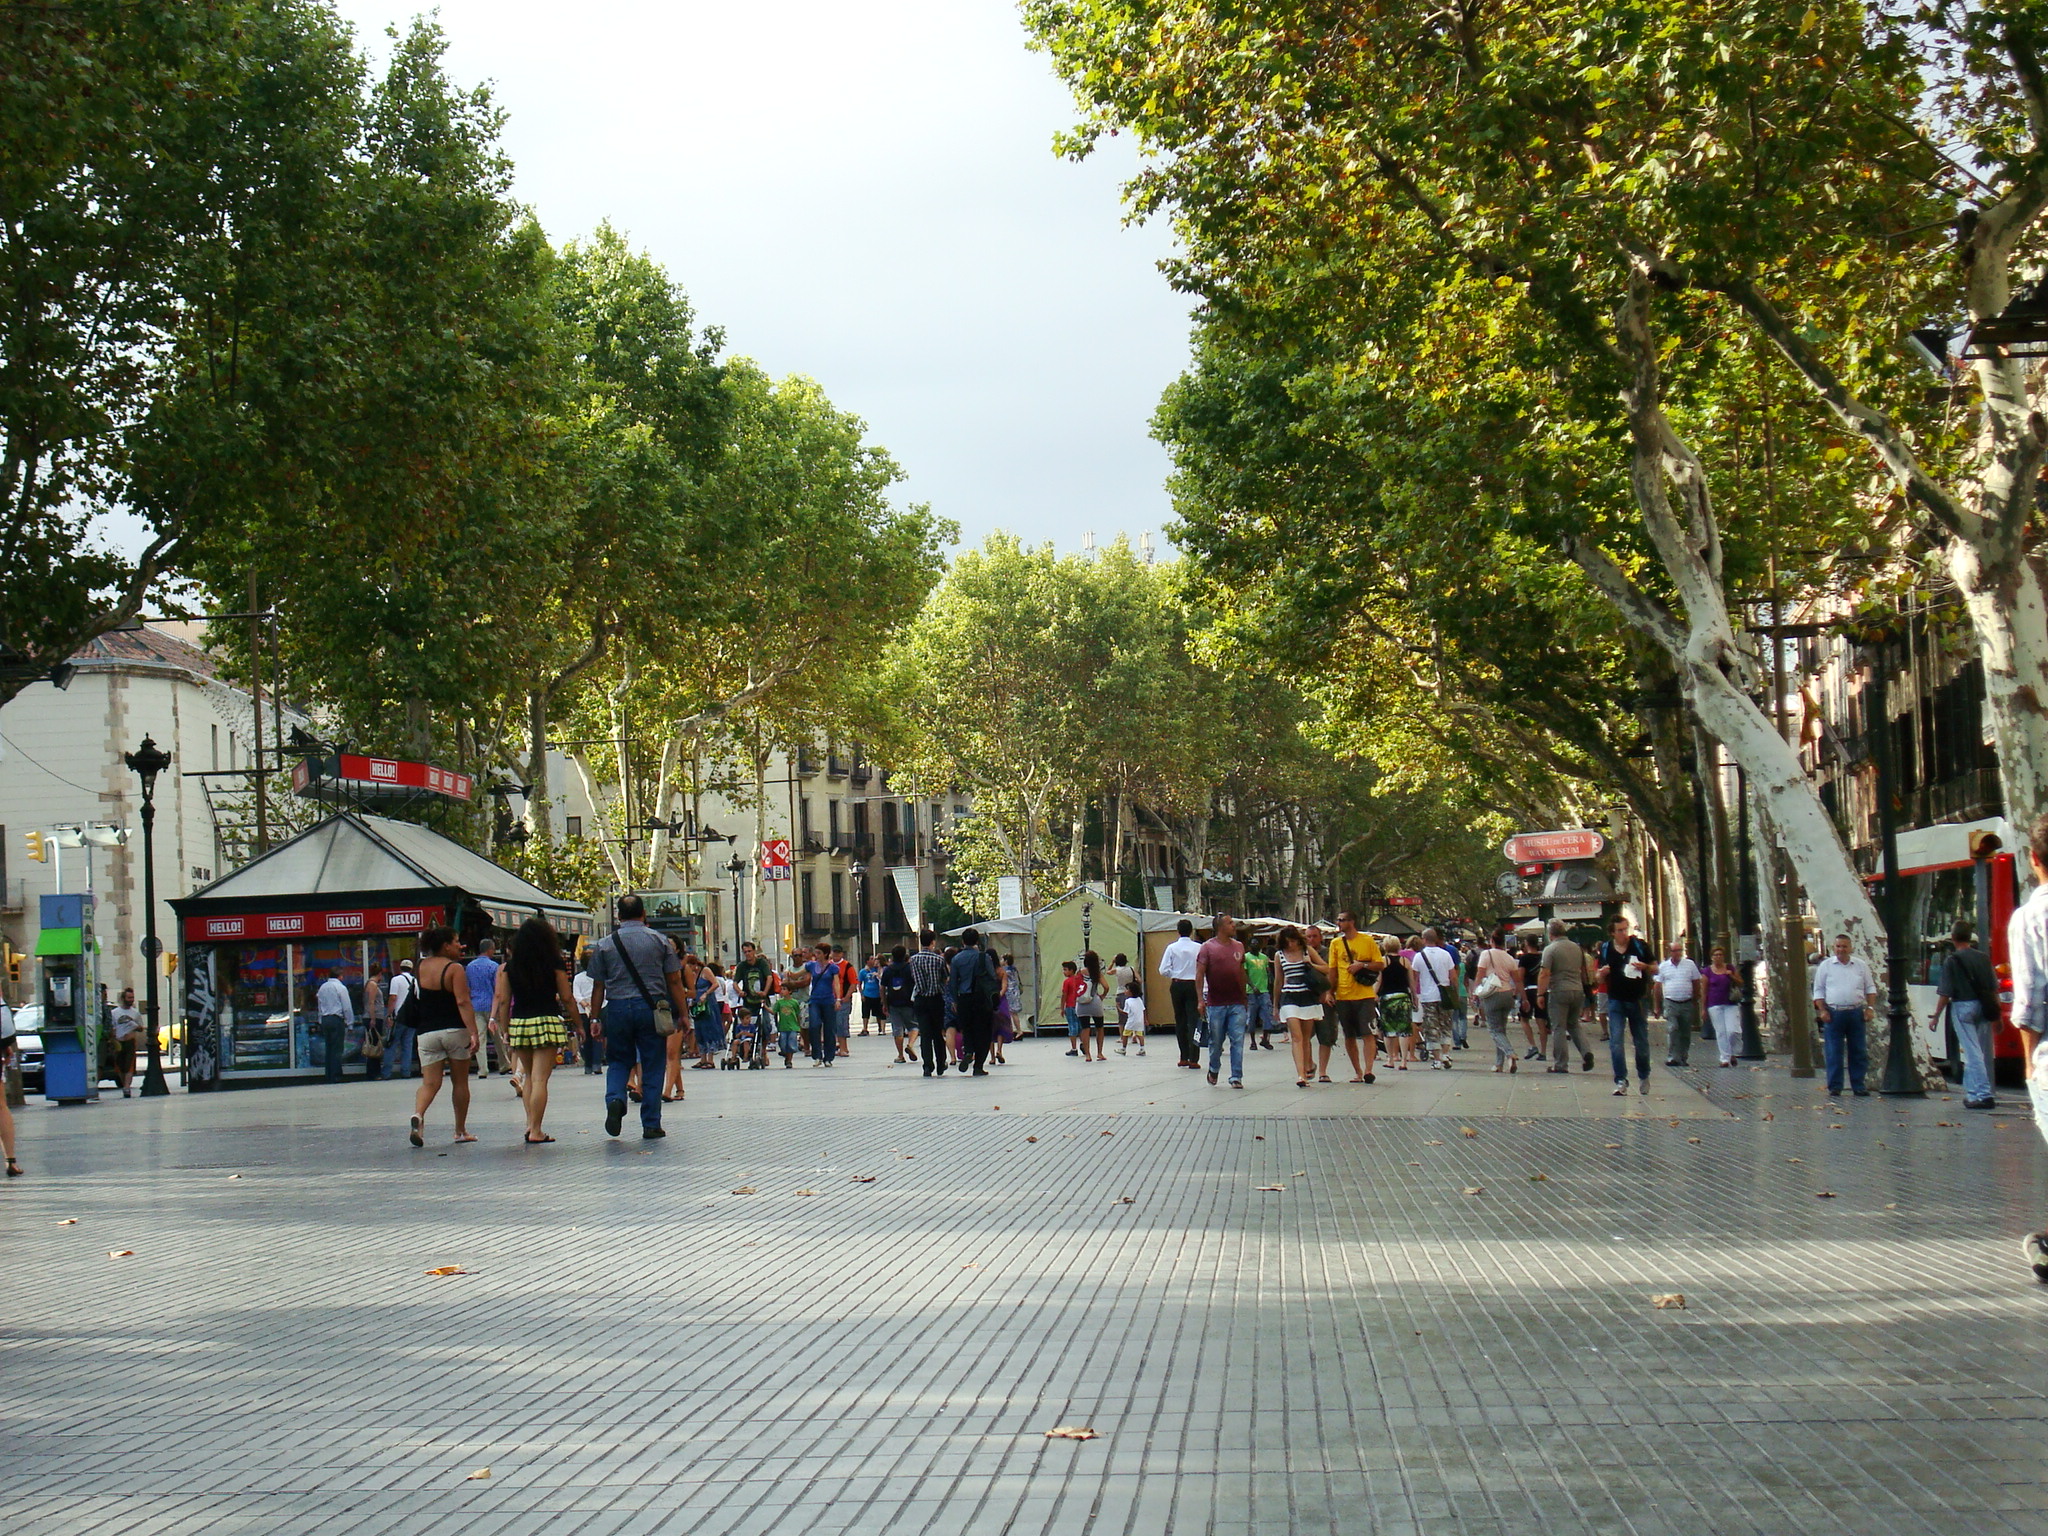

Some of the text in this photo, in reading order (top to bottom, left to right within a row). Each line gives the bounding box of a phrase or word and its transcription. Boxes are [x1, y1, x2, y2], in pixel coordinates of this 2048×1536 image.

[371, 762, 396, 778] HELLO!
[1522, 838, 1552, 847] MUSEU
[1562, 836, 1586, 845] CERA
[1546, 846, 1580, 856] MUSEUM
[269, 918, 301, 931] HELLO!
[329, 915, 361, 928] HELLO!
[388, 913, 421, 926] HELLO!
[209, 921, 242, 934] HELLO!
